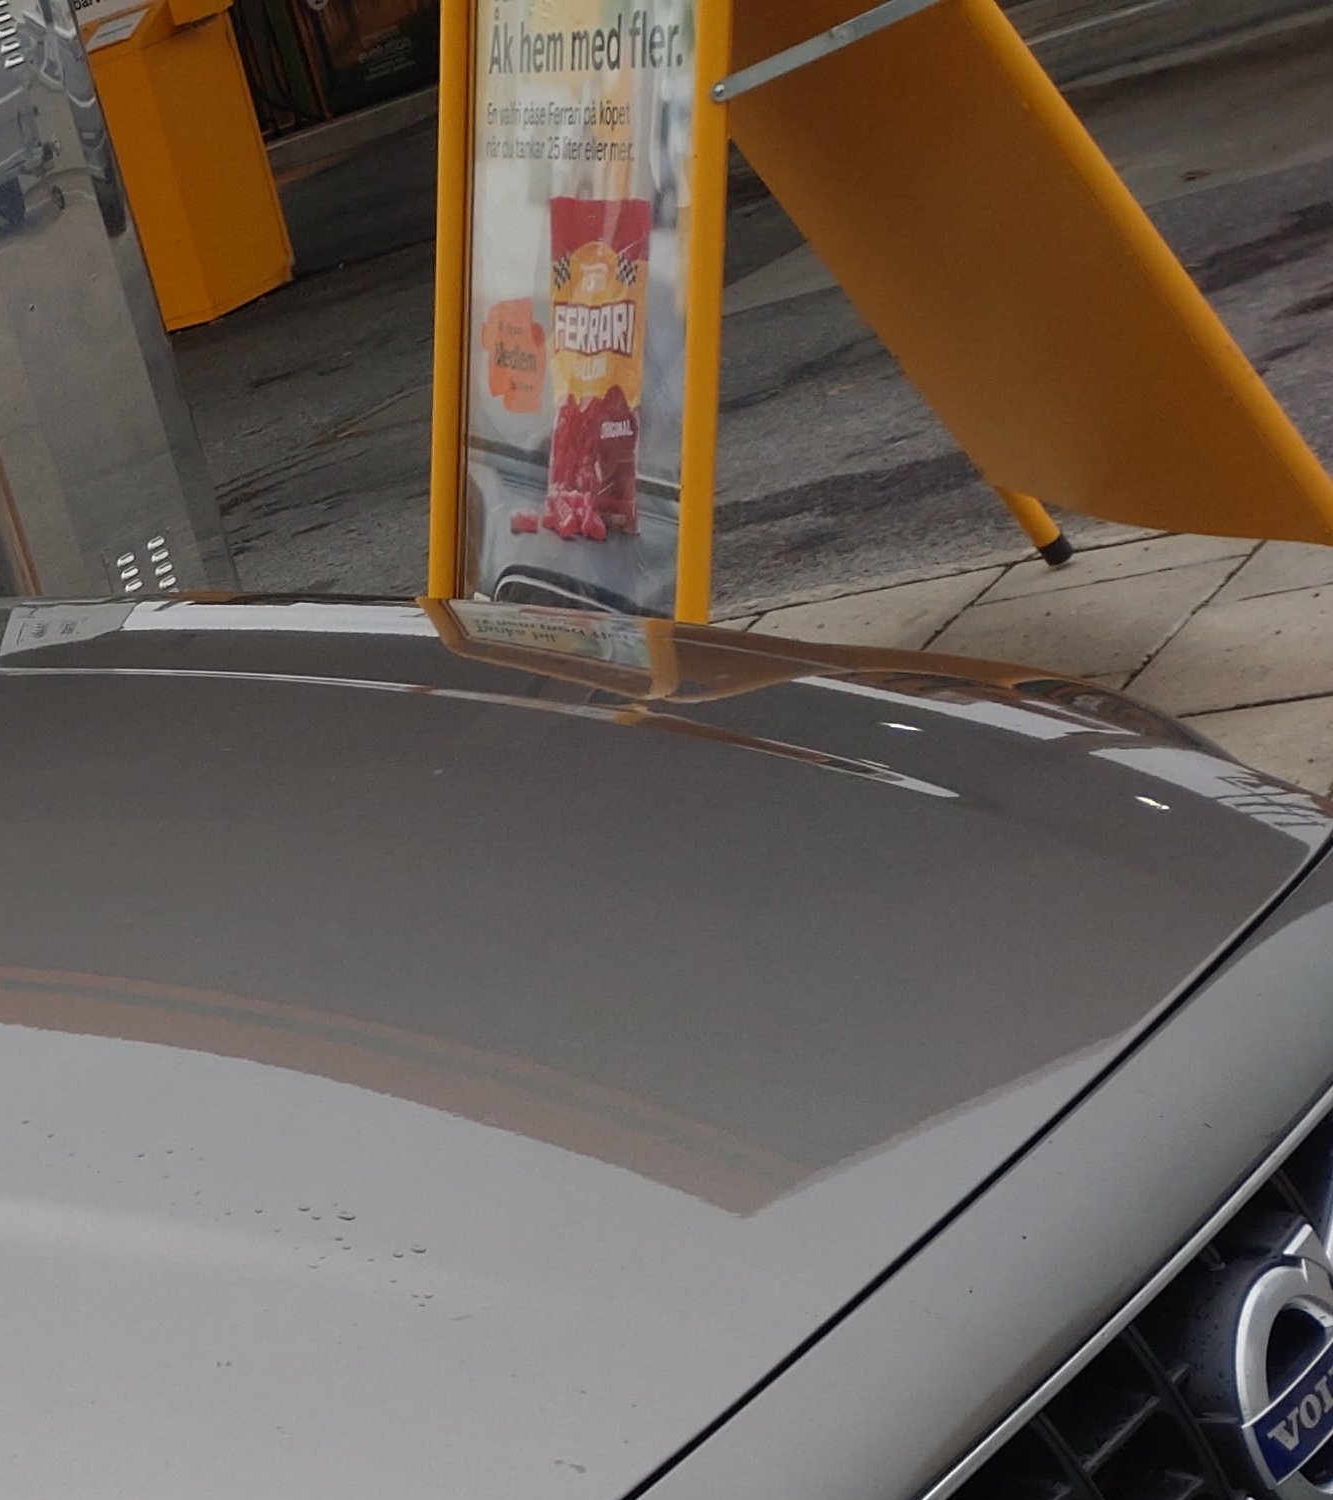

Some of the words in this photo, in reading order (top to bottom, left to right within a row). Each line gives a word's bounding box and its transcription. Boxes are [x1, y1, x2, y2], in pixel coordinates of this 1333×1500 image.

[489, 7, 514, 74] Åk
[519, 21, 564, 73] hem
[571, 13, 622, 71] med
[629, 11, 683, 69] fler.
[487, 102, 498, 125] En
[523, 101, 546, 130] påse
[548, 101, 581, 125] Ferrari
[583, 100, 597, 131] på
[599, 100, 631, 131] köpet
[548, 136, 561, 160] 25
[563, 136, 583, 161] liter
[585, 138, 608, 161] eller
[555, 304, 635, 353] FERRARI
[1266, 1365, 1333, 1452] VOL
